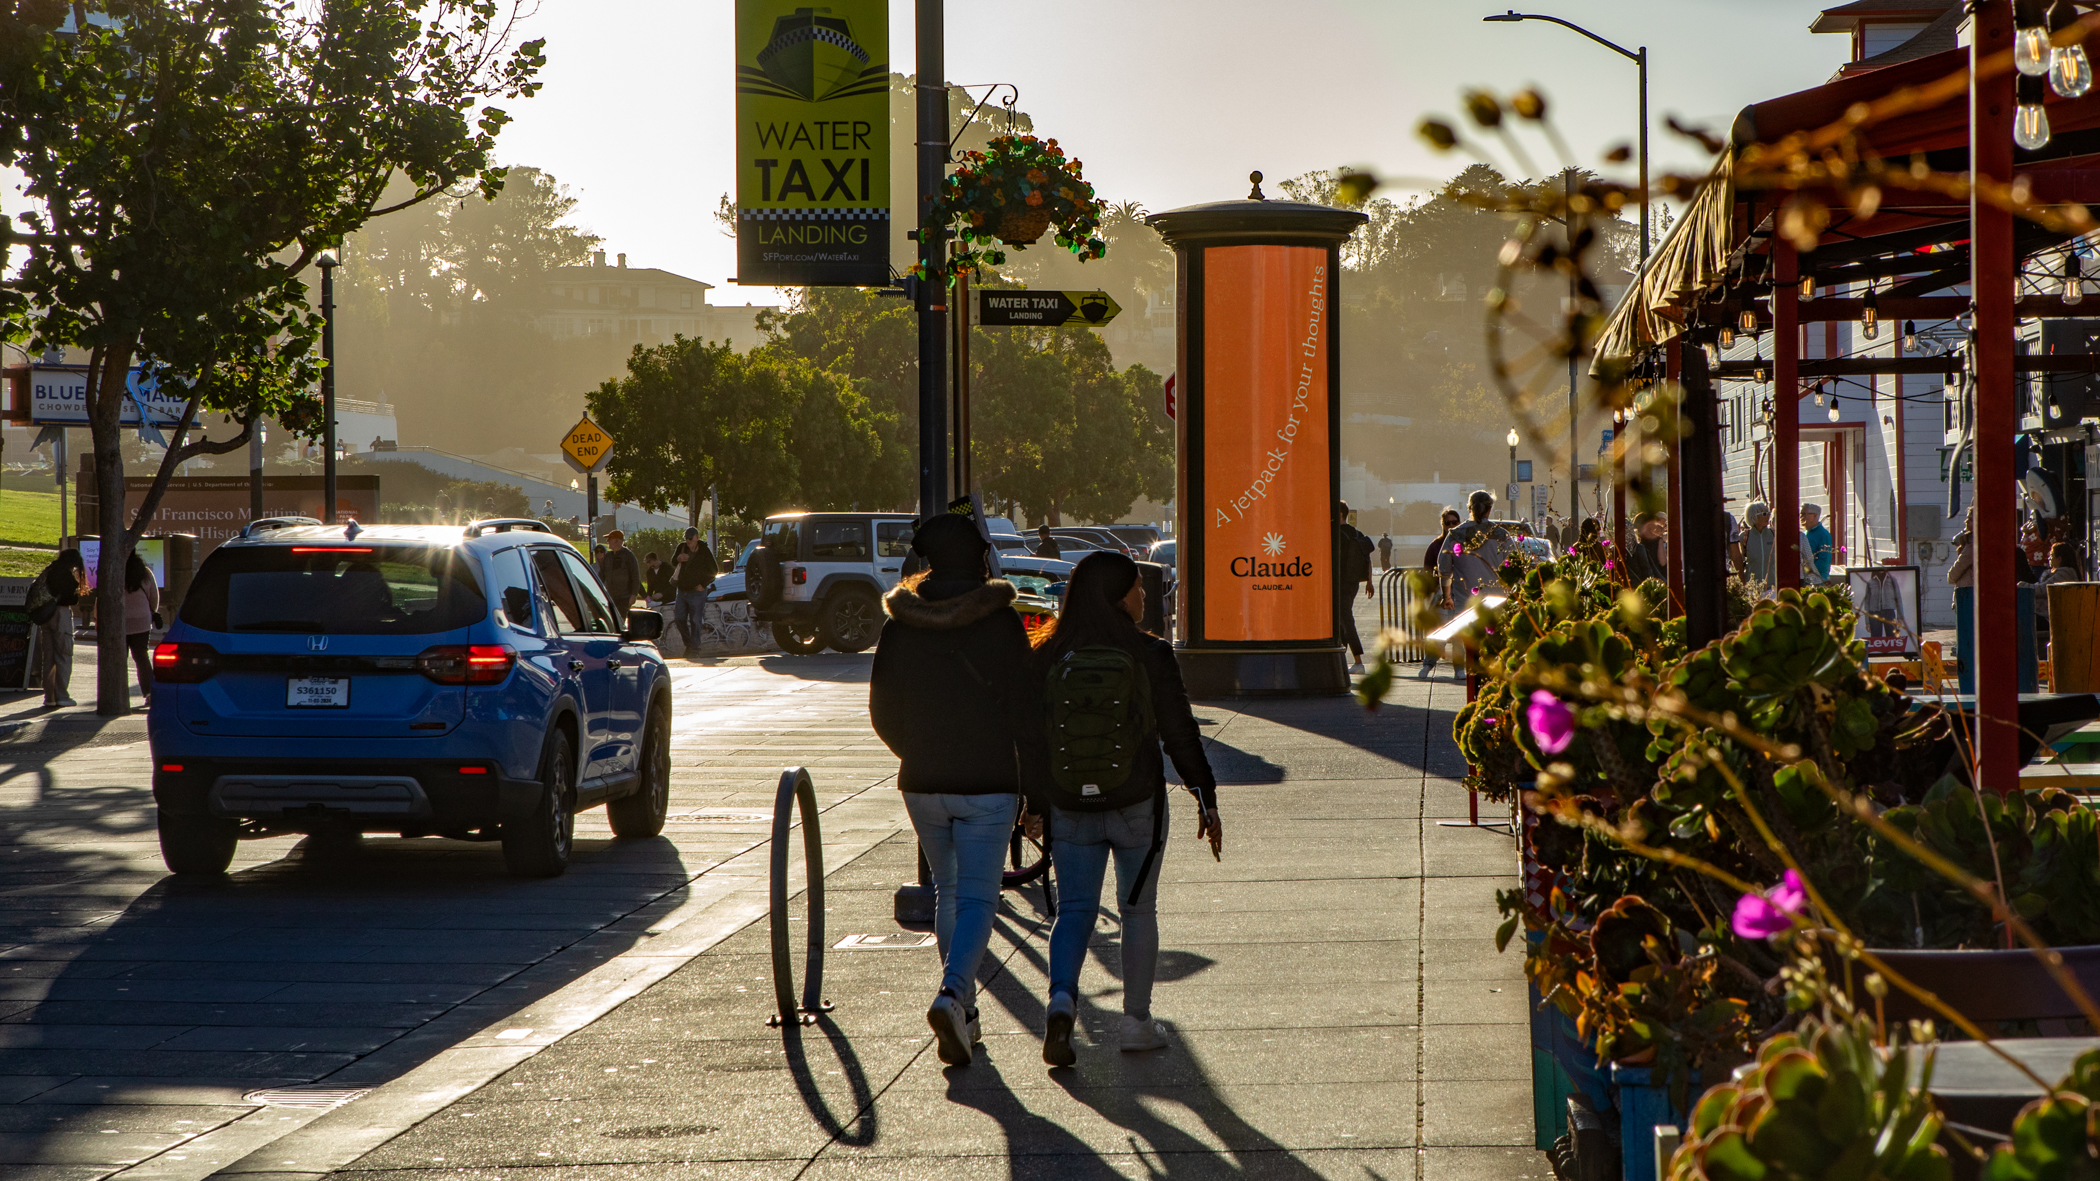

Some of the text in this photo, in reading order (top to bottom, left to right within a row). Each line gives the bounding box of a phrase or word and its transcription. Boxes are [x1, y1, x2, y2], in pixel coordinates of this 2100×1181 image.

[755, 121, 871, 150] WATER
[754, 158, 870, 202] TAXI
[758, 224, 868, 244] LANDING
[988, 297, 1059, 309] WATER TAXI
[1009, 312, 1043, 320] LANDING
[35, 384, 86, 400] BLUE
[1216, 265, 1325, 528] A jetpack for your thoughts
[38, 403, 87, 412] CHOWDE
[159, 406, 182, 414] BAR
[572, 433, 602, 444] DEAD
[577, 446, 599, 457] END
[130, 507, 307, 521] Sn Francisco Mritime
[1230, 556, 1313, 578] Claude
[297, 687, 337, 695] S361150
